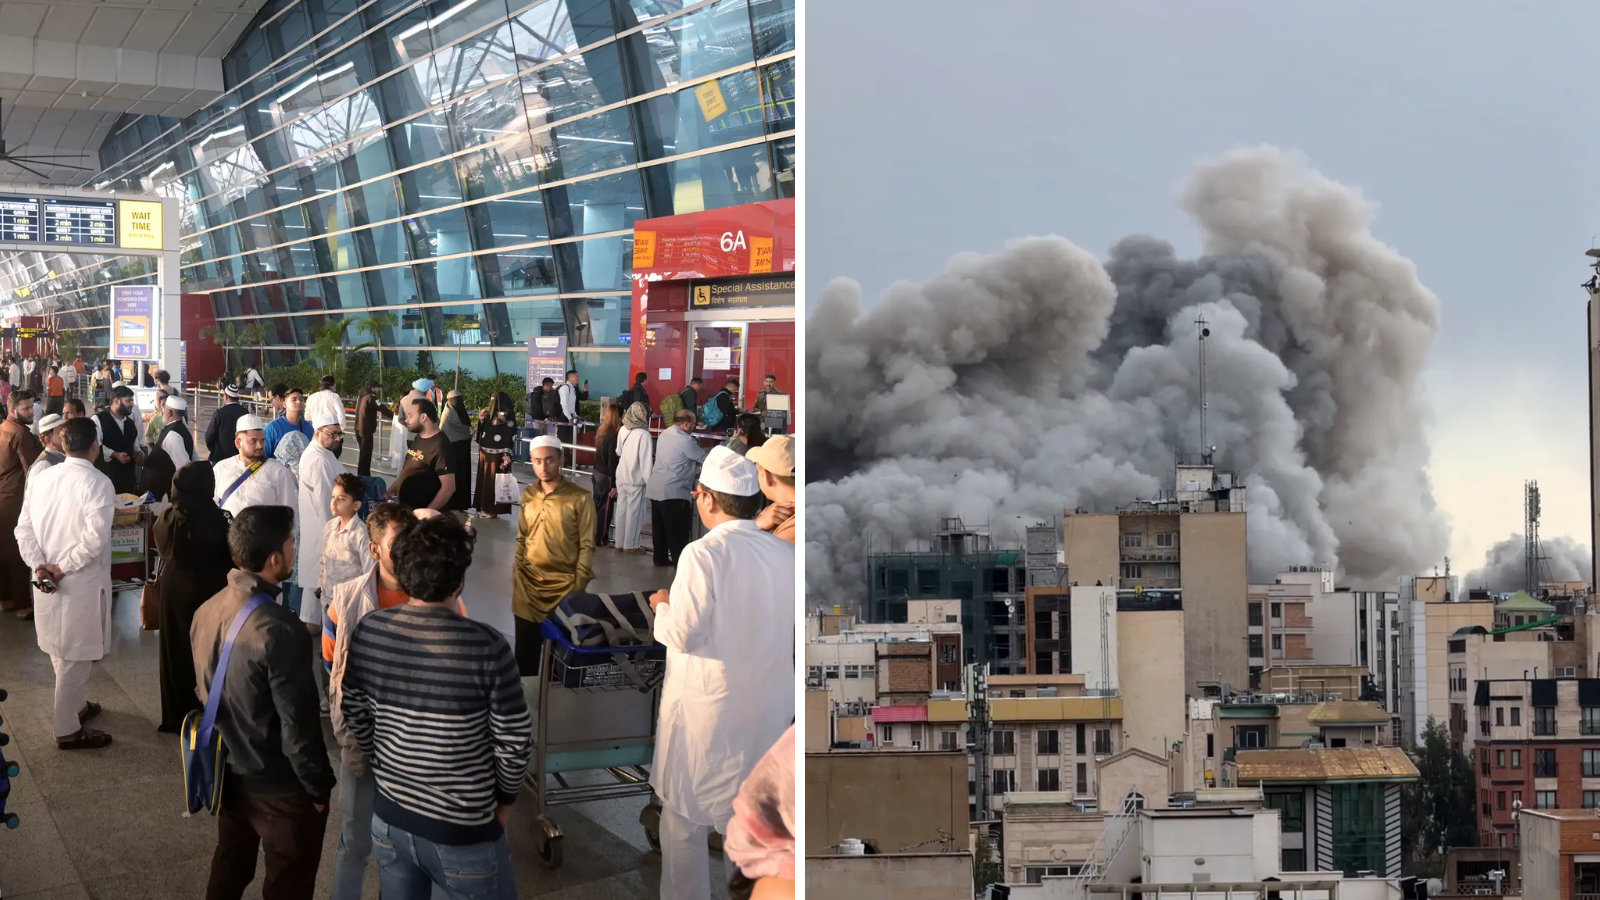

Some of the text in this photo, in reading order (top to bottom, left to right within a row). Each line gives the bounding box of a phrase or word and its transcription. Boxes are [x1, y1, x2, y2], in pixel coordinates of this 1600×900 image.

[132, 212, 151, 220] WAIT
[132, 222, 151, 231] TIME
[720, 230, 746, 252] 6A
[711, 281, 795, 295] Special Assistance
[711, 296, 748, 304] विशेष सहायता
